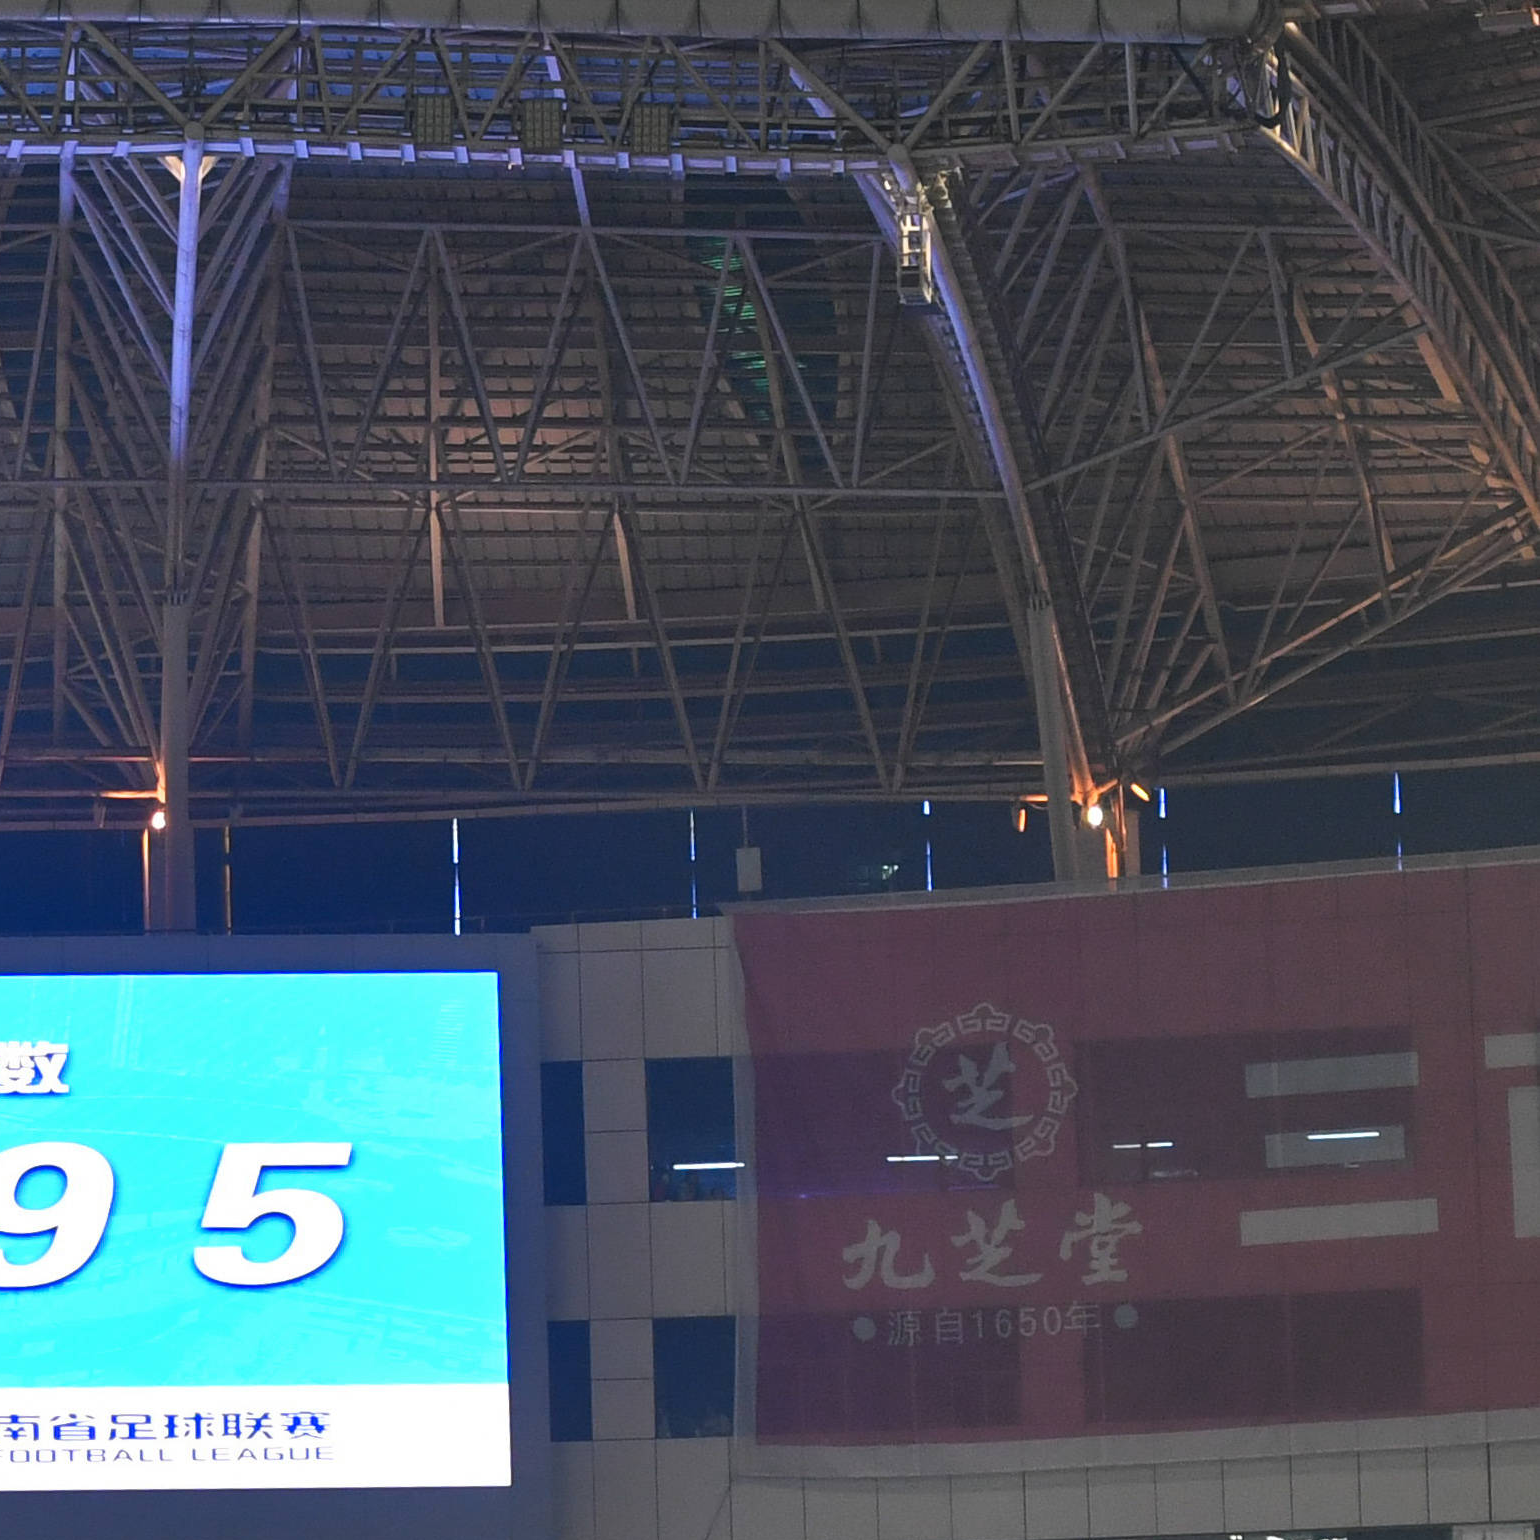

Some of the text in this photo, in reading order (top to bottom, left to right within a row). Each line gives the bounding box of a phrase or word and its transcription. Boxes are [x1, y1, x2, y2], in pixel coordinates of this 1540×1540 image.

[842, 1192, 1142, 1288] 九芝堂
[192, 1445, 334, 1462] LEAGUE
